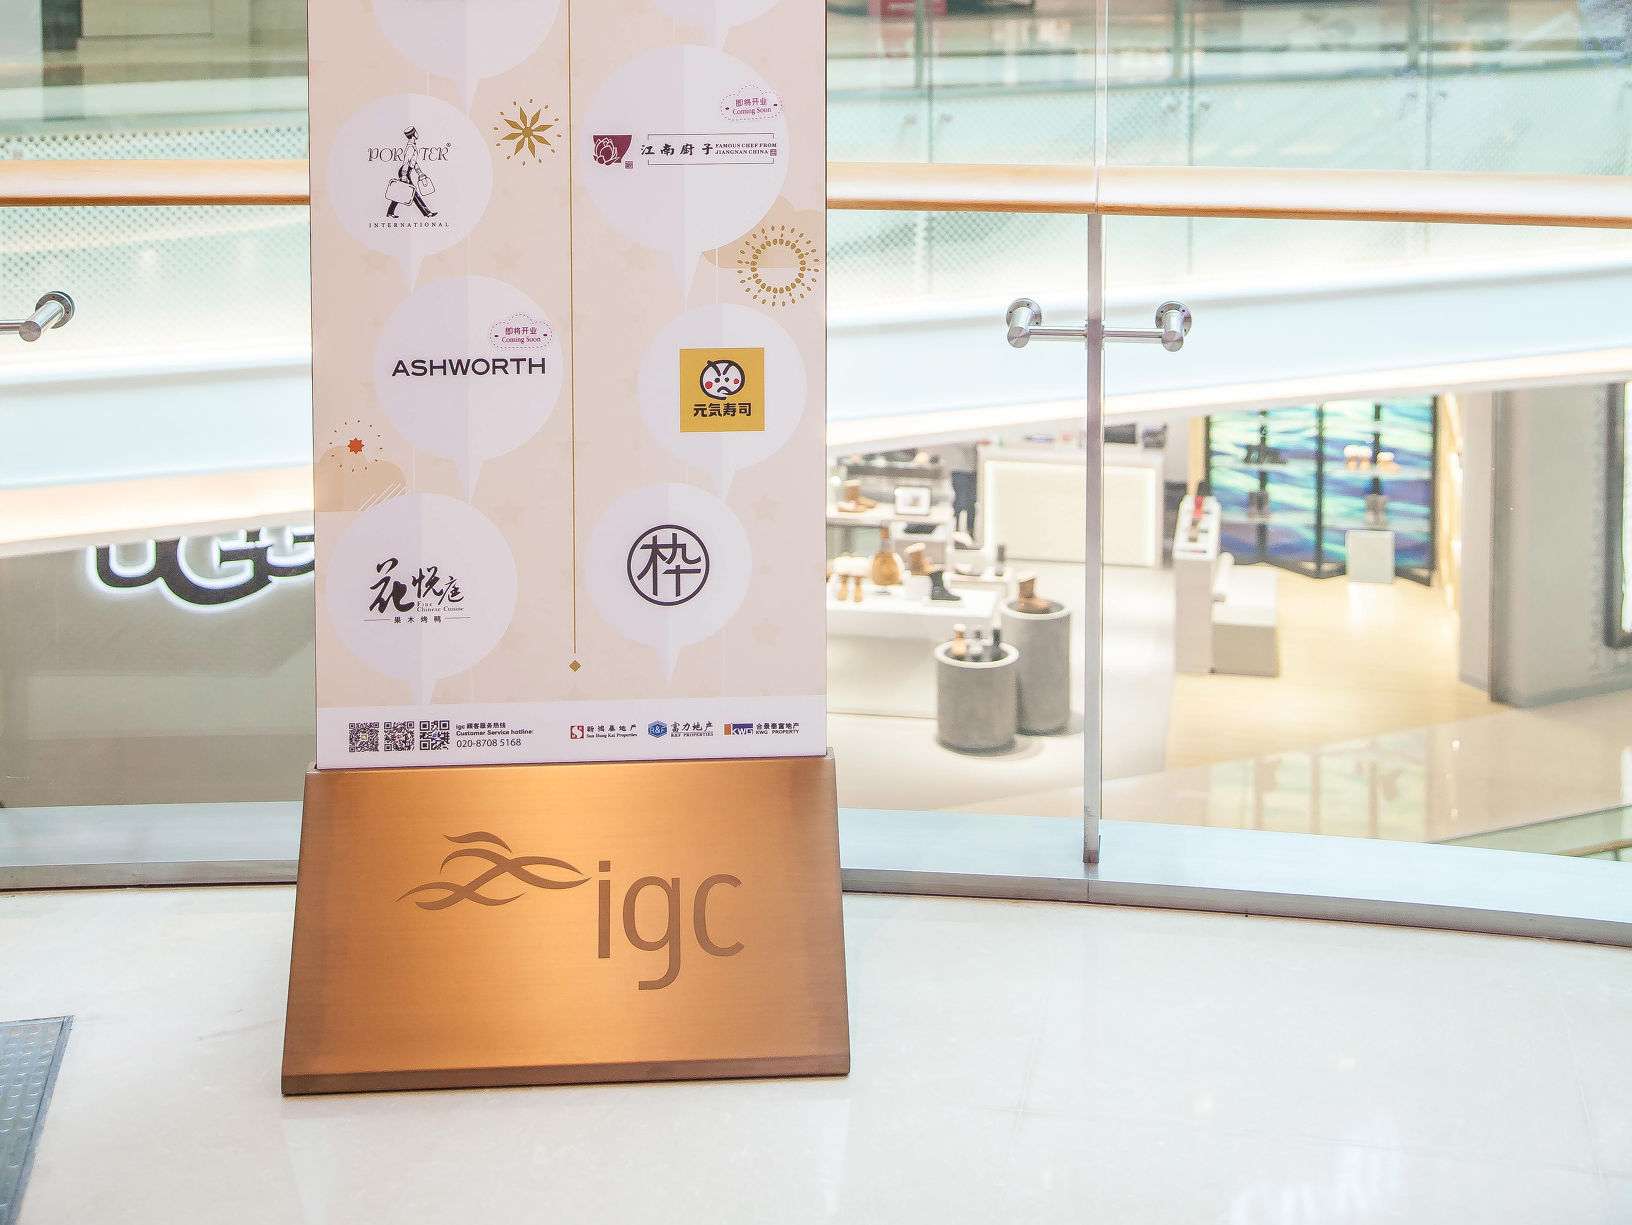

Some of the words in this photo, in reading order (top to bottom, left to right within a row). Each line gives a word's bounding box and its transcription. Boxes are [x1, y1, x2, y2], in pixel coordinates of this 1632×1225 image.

[736, 98, 767, 108] 即将开业
[732, 107, 755, 116] Coming
[641, 144, 713, 156] 江南厨子
[506, 327, 537, 335] 即将开业
[501, 335, 524, 344] Coming
[525, 335, 541, 343] Soon
[392, 358, 545, 376] ASHWORTH
[369, 558, 463, 613] 花悦庭
[457, 739, 497, 747] 020-8708
[598, 860, 745, 991] igc
